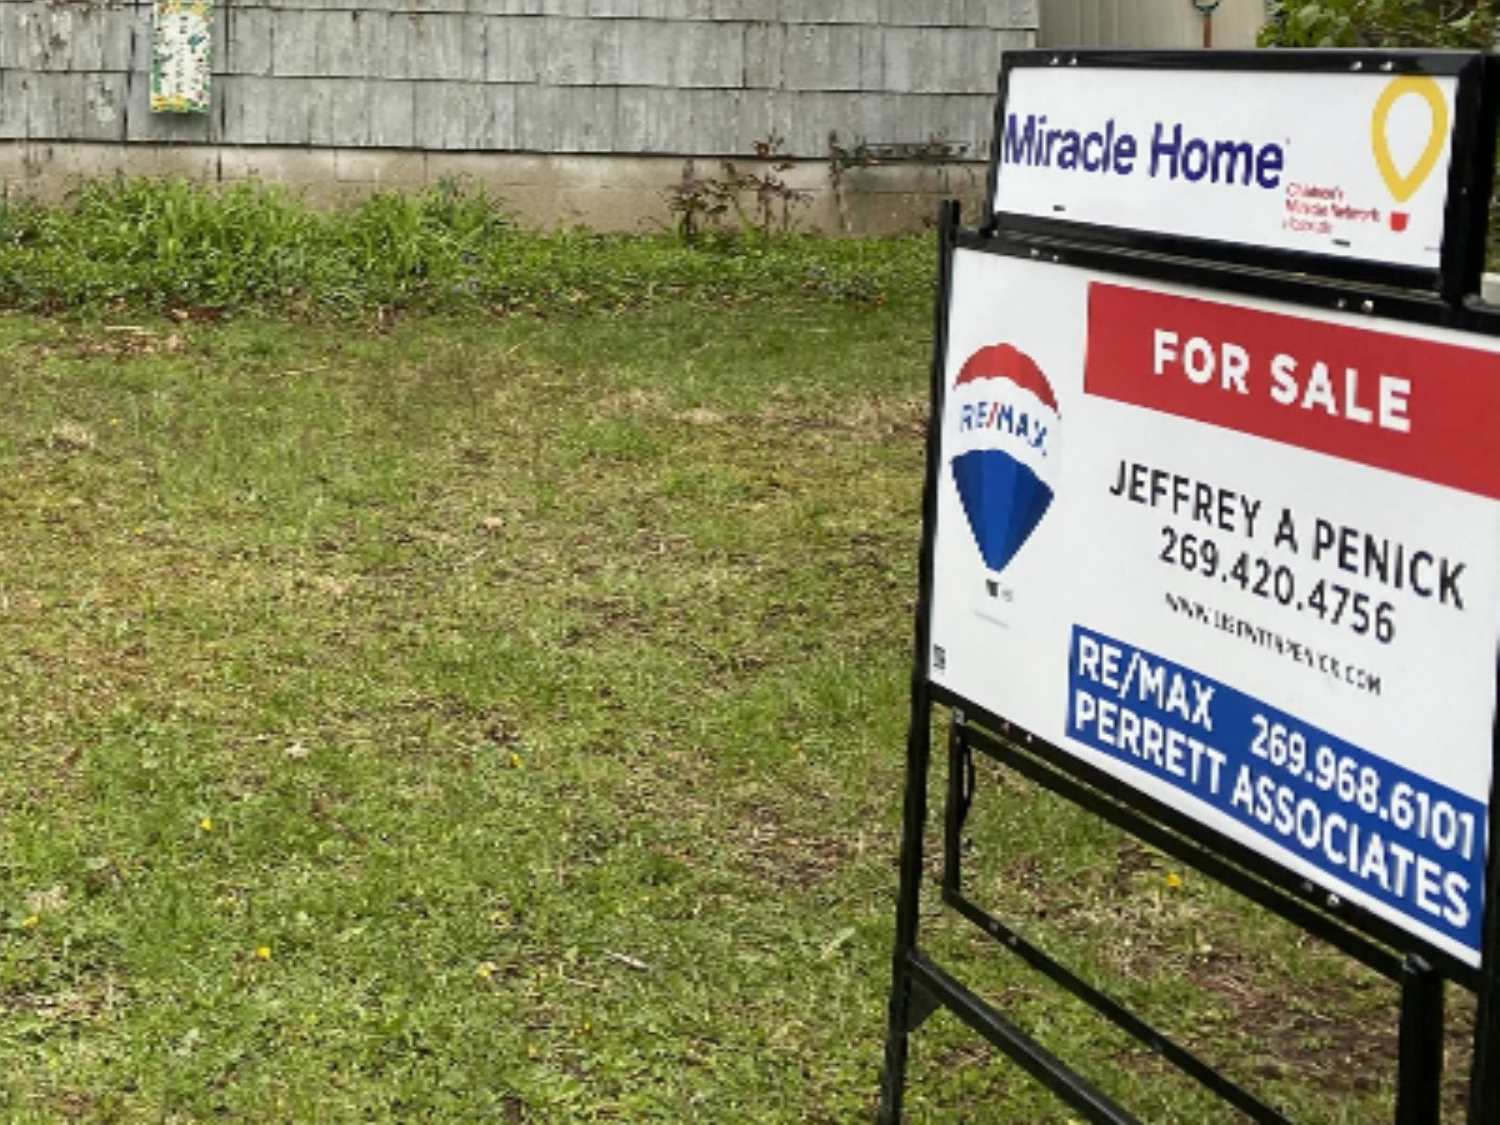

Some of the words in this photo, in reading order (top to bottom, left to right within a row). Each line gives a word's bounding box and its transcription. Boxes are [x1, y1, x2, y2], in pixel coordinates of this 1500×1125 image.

[1003, 112, 1137, 175] Miracle
[1148, 121, 1284, 189] Home
[959, 401, 1048, 448] RE/MAX
[1153, 328, 1250, 395] FOR
[1269, 353, 1412, 433] SALE
[1108, 459, 1262, 539] JEFFREY
[1273, 507, 1299, 555] A
[1312, 518, 1468, 611] PENICK
[1158, 524, 1397, 645] 269.420.4756
[1077, 633, 1216, 732] RE/MAX
[1249, 713, 1476, 861] 269.968.6101
[1073, 688, 1227, 795] PERRETT
[1229, 763, 1472, 930] ASSOCIATES
